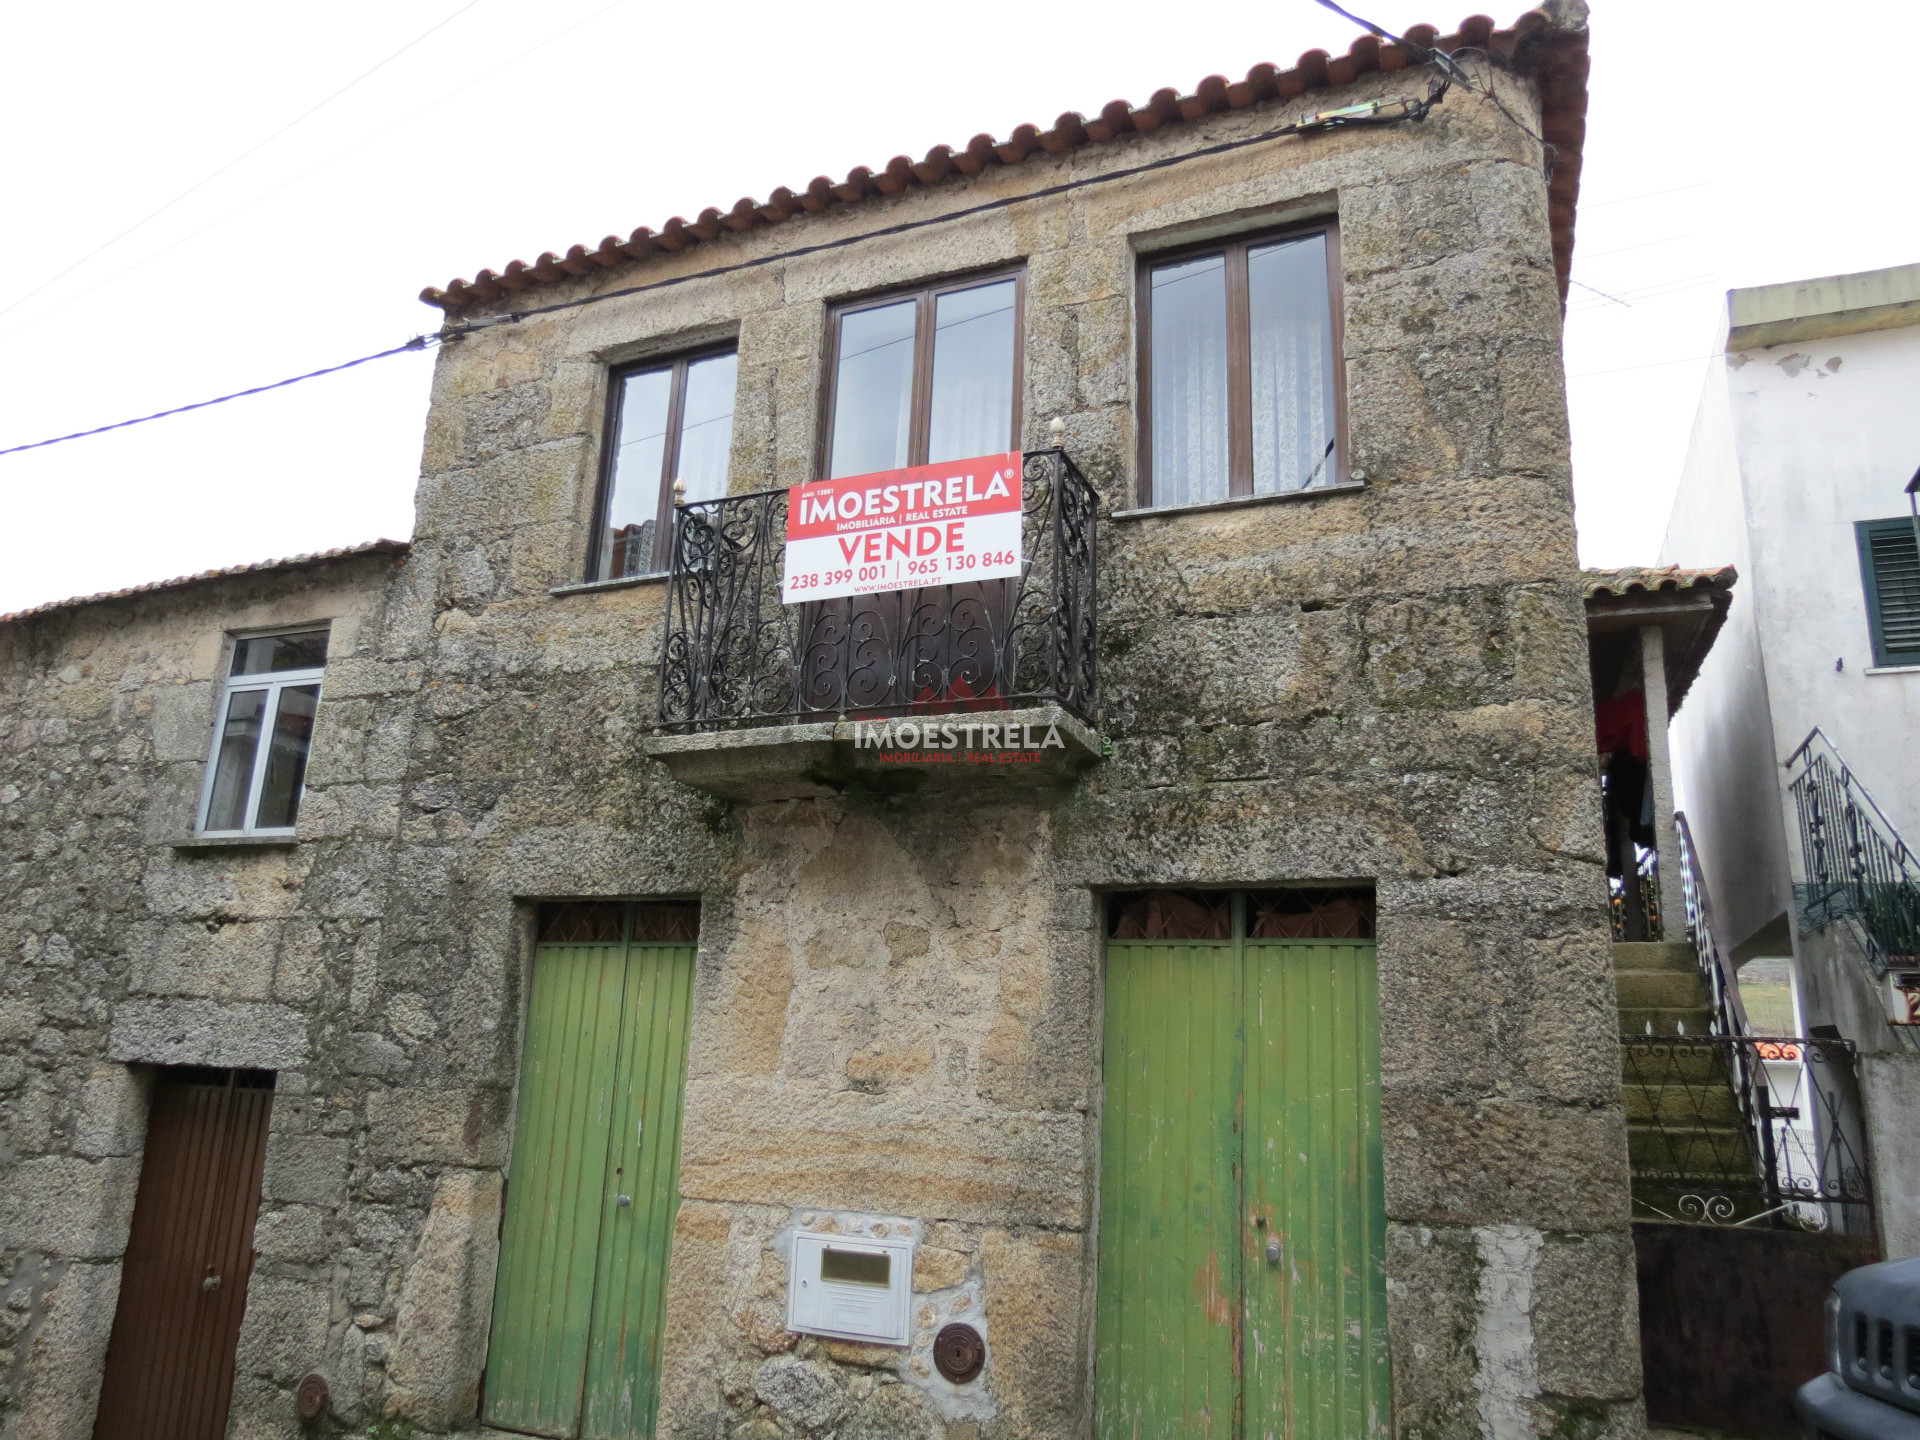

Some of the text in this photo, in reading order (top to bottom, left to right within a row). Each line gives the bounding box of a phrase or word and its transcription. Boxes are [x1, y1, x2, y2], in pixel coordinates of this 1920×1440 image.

[799, 471, 1010, 525] IMOESTRELA
[836, 514, 896, 532] IMOBILIÁRIA
[905, 510, 930, 522] REAL
[932, 505, 968, 518] ESTATE
[838, 521, 965, 566] VENDE
[790, 573, 818, 590] 238
[823, 568, 853, 586] 399
[858, 564, 887, 582] 001
[907, 557, 938, 575] 965
[946, 552, 976, 571] 130
[982, 549, 1015, 567] 846
